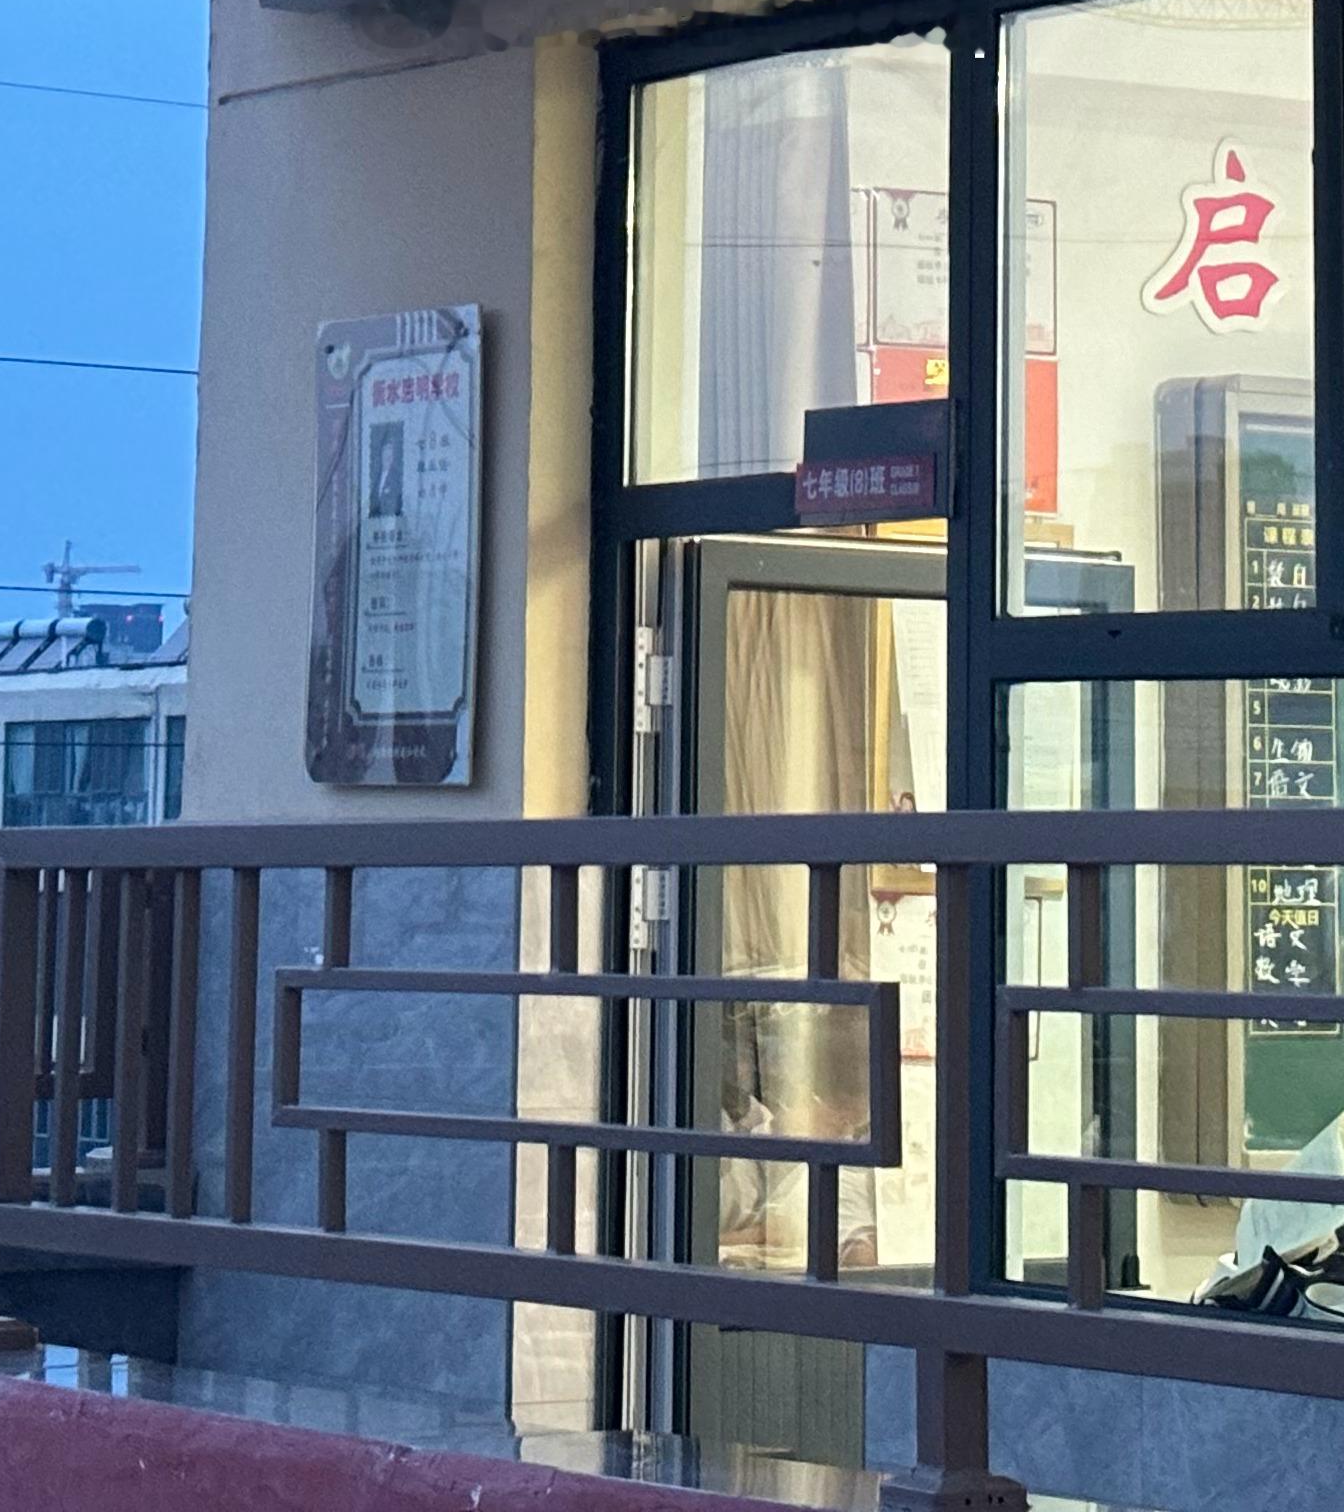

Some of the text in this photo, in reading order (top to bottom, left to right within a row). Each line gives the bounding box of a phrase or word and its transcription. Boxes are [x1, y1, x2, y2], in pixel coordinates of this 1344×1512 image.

[1251, 559, 1259, 574] 1
[1251, 594, 1261, 609] 2
[1252, 699, 1262, 716] 5
[1252, 735, 1262, 752] 6
[1252, 771, 1262, 786] 7
[1268, 768, 1315, 799] 语文
[1251, 879, 1268, 894] 10
[1271, 878, 1323, 905] 地理
[1268, 908, 1320, 926] 今天值日
[1253, 923, 1308, 951] 语文
[1254, 954, 1311, 988] 数学
